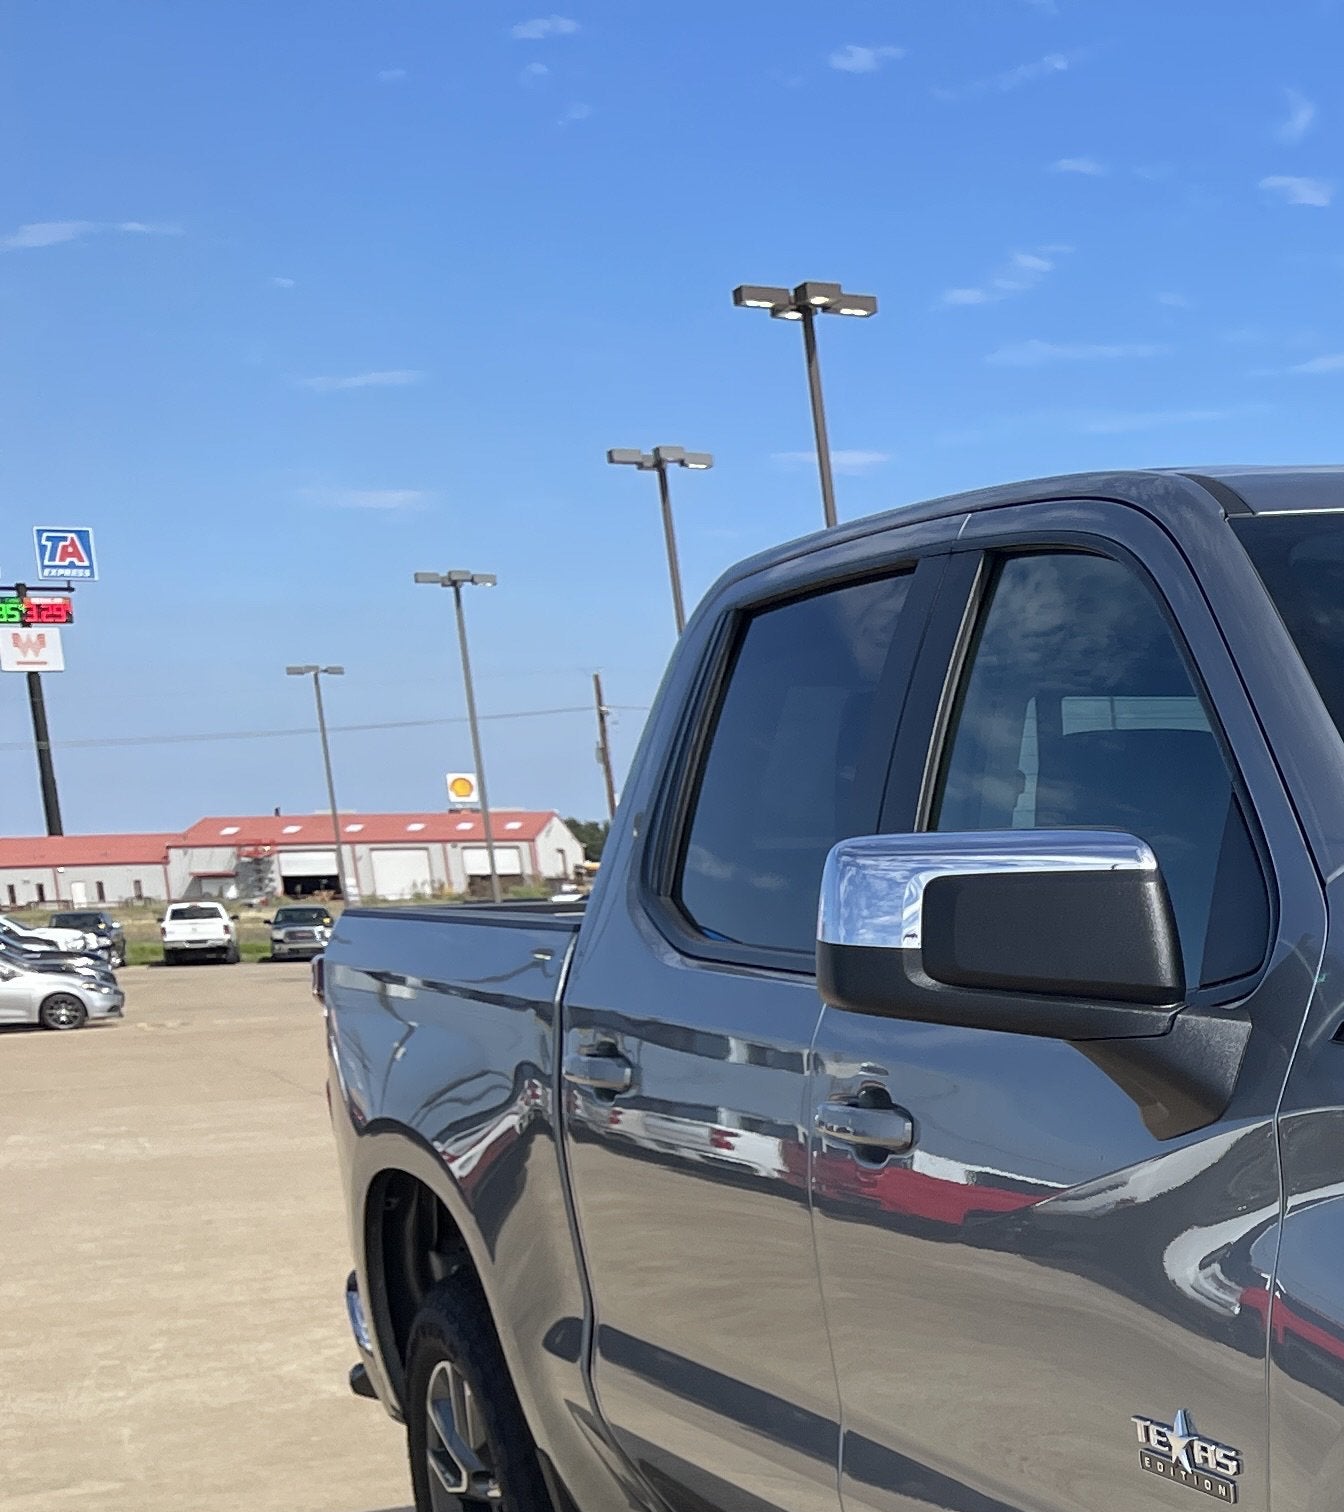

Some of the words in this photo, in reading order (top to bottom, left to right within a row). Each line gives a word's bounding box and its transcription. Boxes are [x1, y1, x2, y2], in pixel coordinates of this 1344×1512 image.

[41, 532, 90, 566] TA
[43, 568, 91, 577] EXPRESS
[1130, 1408, 1242, 1476] TEXAS
[1143, 1456, 1228, 1497] EDITION
